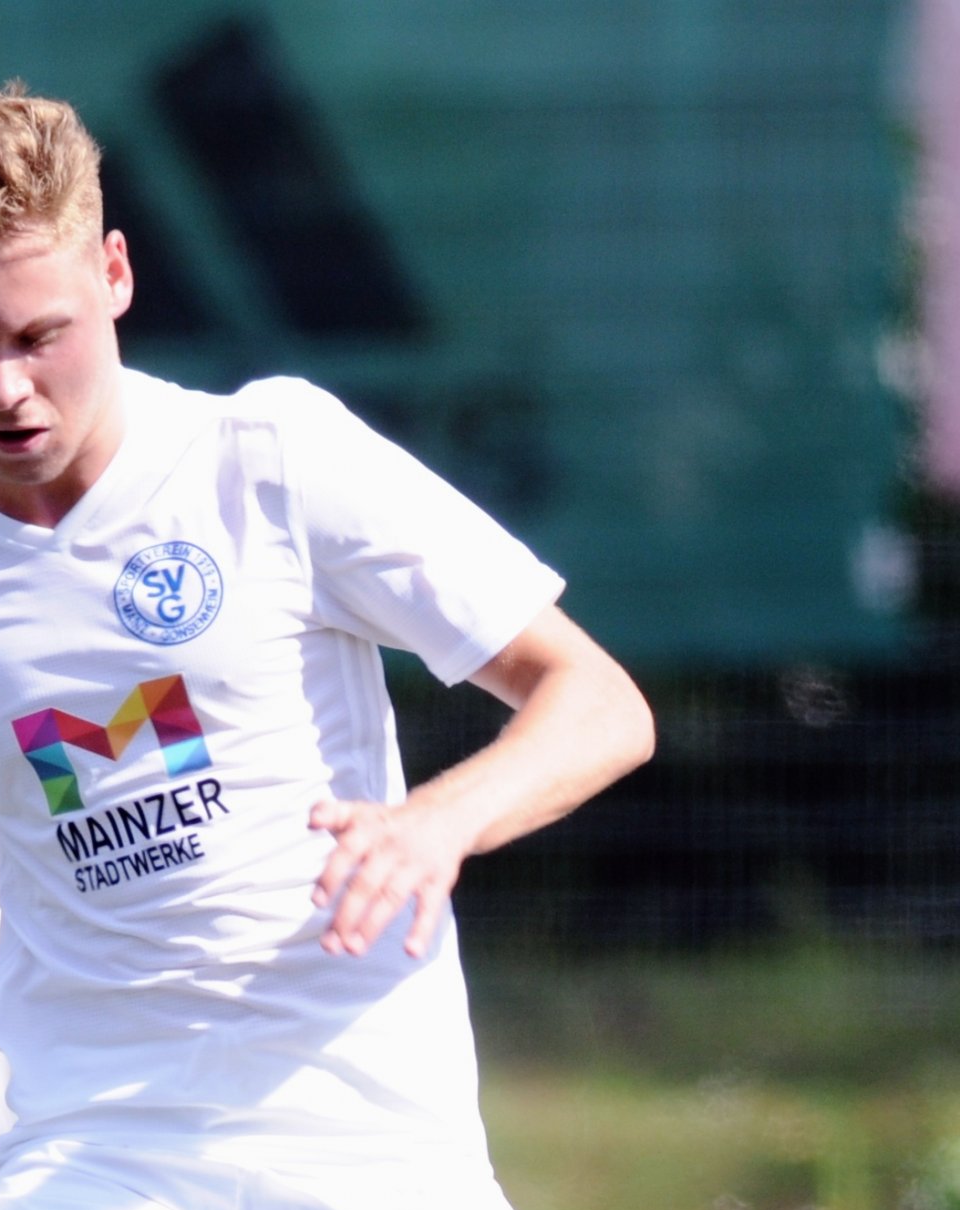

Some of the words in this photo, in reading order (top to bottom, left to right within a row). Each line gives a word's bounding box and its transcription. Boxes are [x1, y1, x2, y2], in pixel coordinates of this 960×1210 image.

[142, 564, 185, 598] SV
[157, 593, 186, 623] G
[56, 778, 230, 863] MAINZER
[74, 834, 205, 893] STADTWERKE
